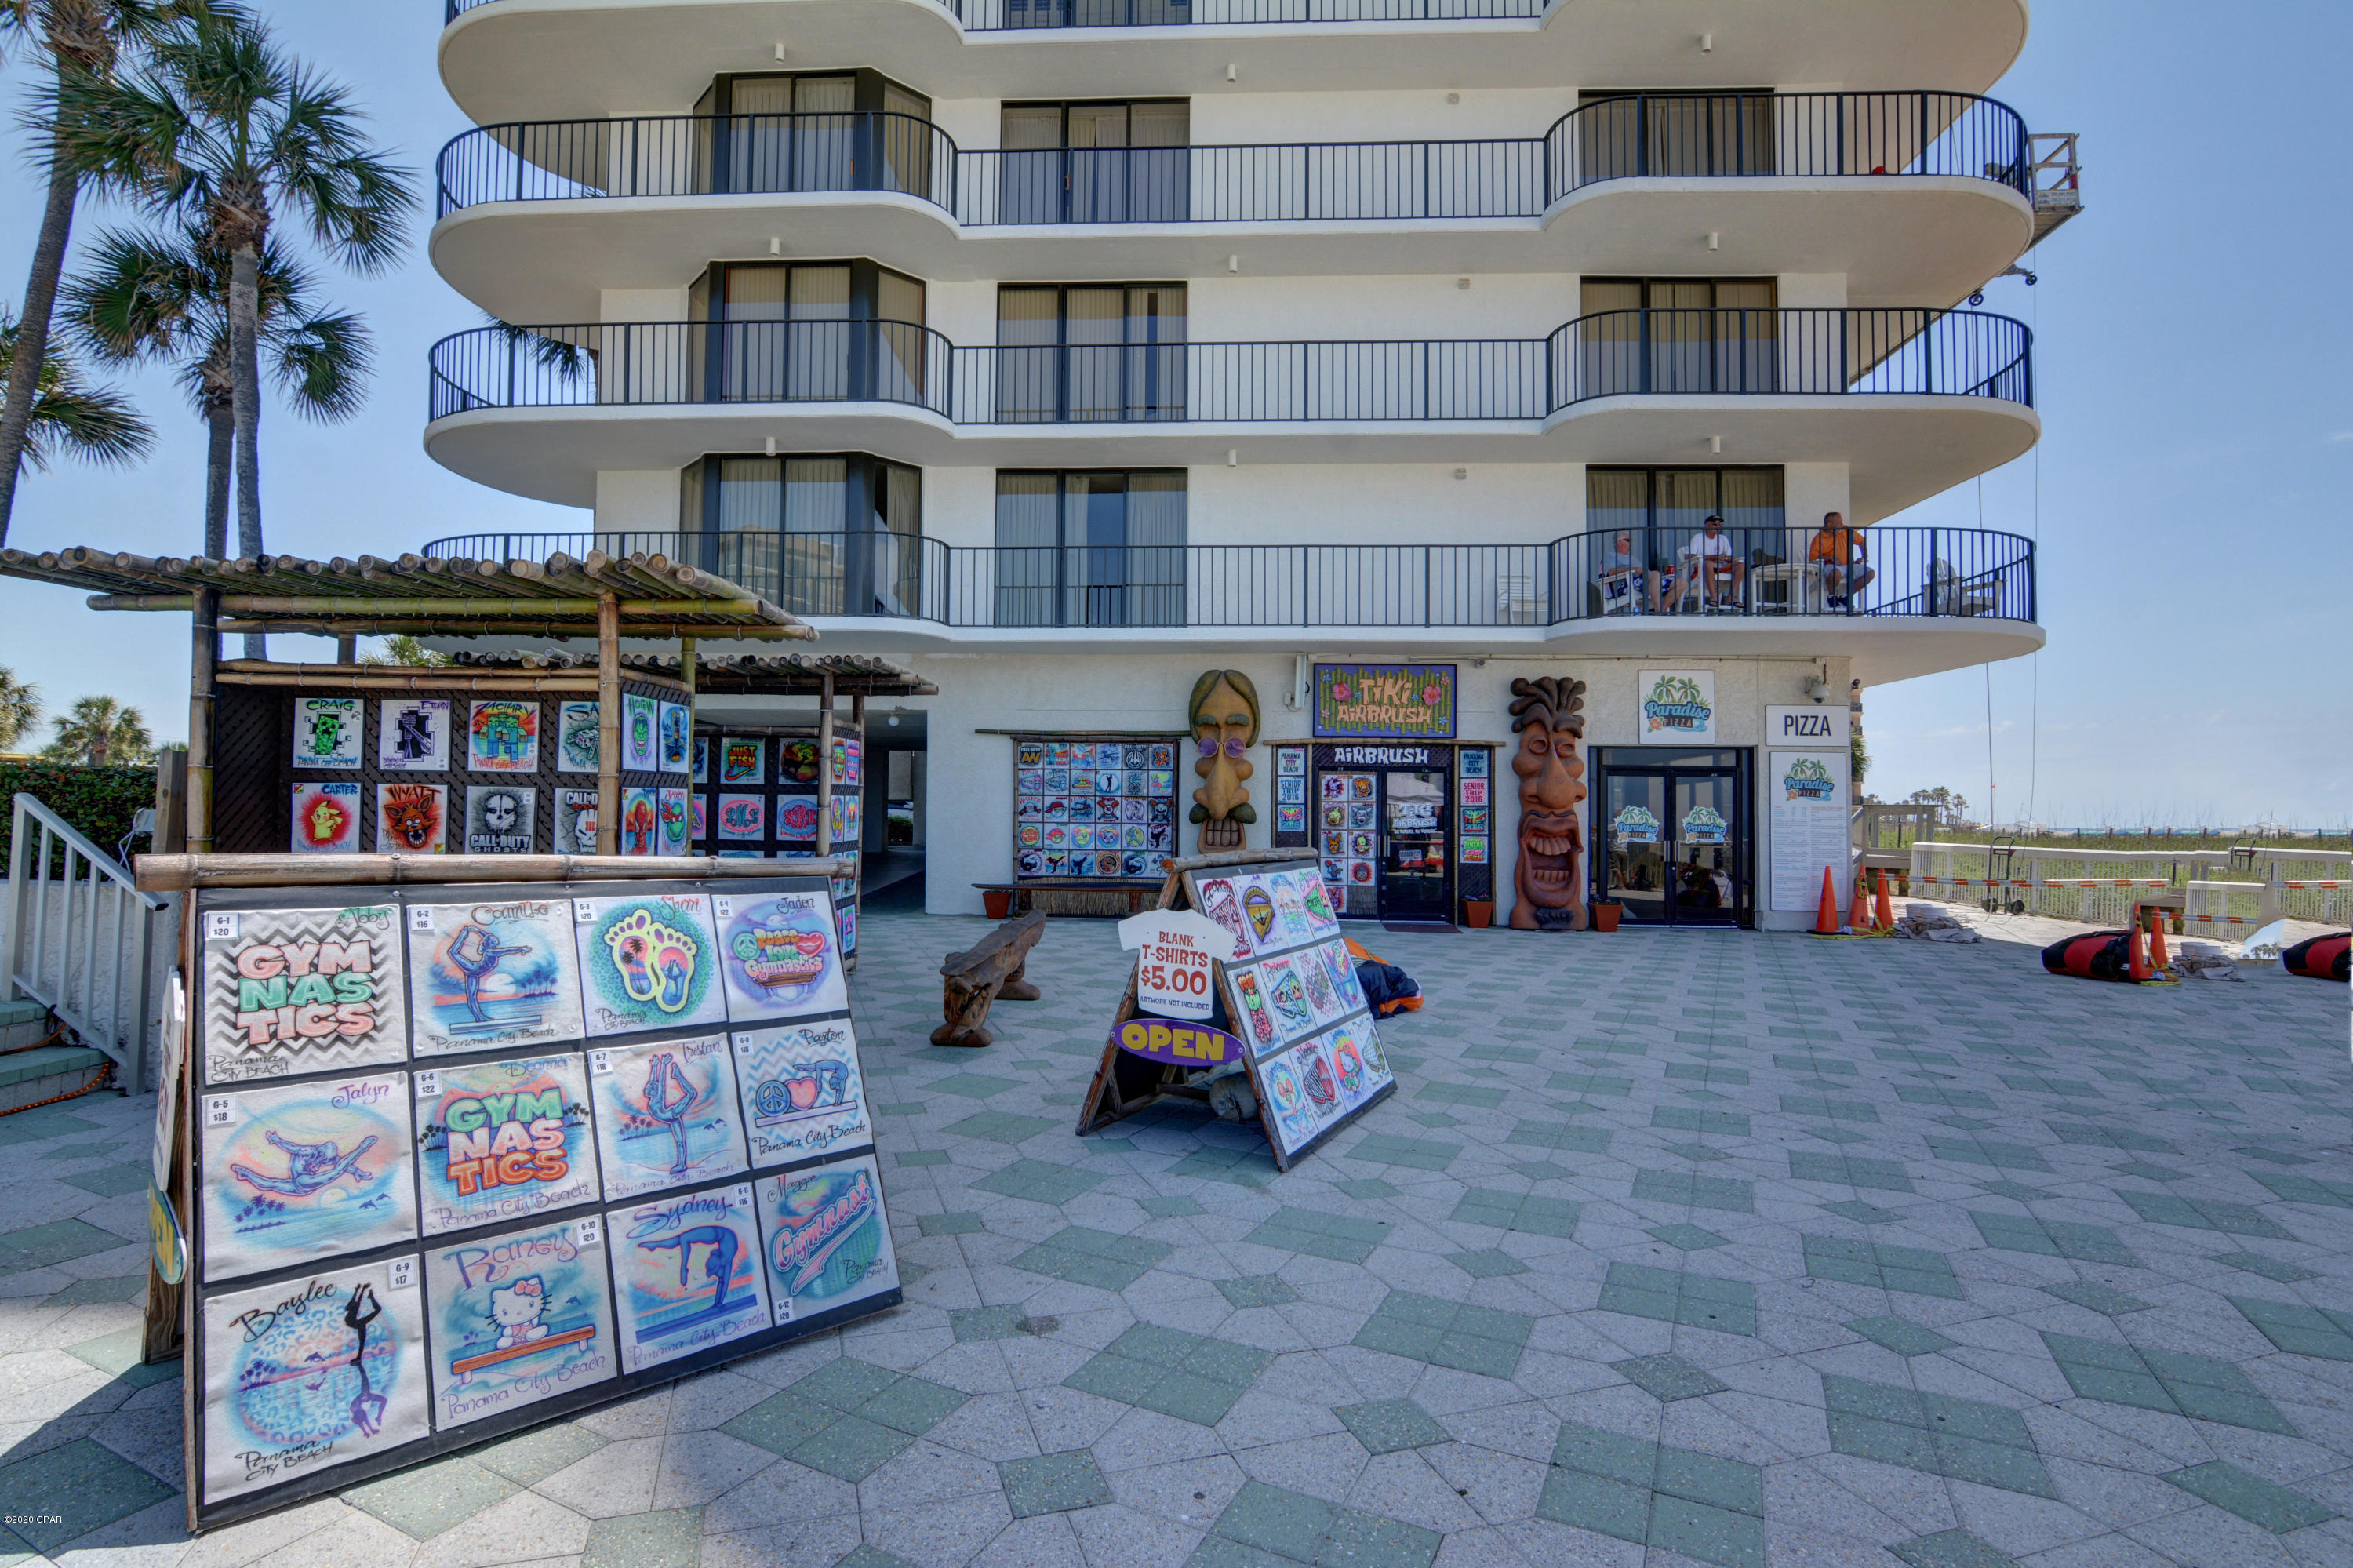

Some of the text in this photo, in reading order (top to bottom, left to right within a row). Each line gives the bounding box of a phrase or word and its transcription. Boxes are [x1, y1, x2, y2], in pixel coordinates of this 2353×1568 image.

[628, 695, 654, 718] HOGAN
[1644, 700, 1711, 721] Paradise
[1664, 718, 1692, 727] PIZZA
[1784, 715, 1831, 737] PIZZA
[729, 745, 757, 756] JUST
[321, 784, 358, 795] CARTER
[387, 784, 442, 802] WYATT
[1281, 780, 1301, 788] SENIOR
[1784, 777, 1835, 792] Paradise
[566, 792, 587, 804] CALL
[1617, 823, 1657, 834] Paradise
[1686, 824, 1726, 834] Paradise
[471, 835, 529, 848] CALL DUTY
[471, 902, 549, 926] Camille
[776, 896, 815, 915] Jaden
[216, 915, 230, 925] G-1
[336, 908, 391, 930] Abby
[416, 920, 427, 929] $16
[214, 928, 229, 937] $20
[753, 927, 800, 950] Peace
[1158, 931, 1195, 948] BLANK
[237, 940, 371, 980] GYM
[765, 944, 799, 962] Love
[1142, 944, 1209, 968] T-SHIRTS
[744, 954, 823, 980] Gymnastics
[1140, 965, 1207, 995] $5.00
[238, 973, 374, 1012] NAS
[1140, 995, 1167, 1006] ARTWORK
[1181, 1001, 1210, 1010] INCLUDED
[237, 1002, 375, 1046] TICS
[595, 1007, 647, 1024] Panama
[427, 1024, 558, 1051] Panama City Beach
[798, 1027, 846, 1048] Paxton
[1121, 1023, 1225, 1061] OPEN
[673, 1041, 723, 1063] Tristan
[207, 1054, 283, 1071] Panama
[245, 1062, 289, 1077] BEACH
[421, 1073, 434, 1082] G-6
[332, 1083, 389, 1109] Jalyn
[421, 1085, 435, 1093] $22
[213, 1101, 228, 1109] G-5
[445, 1086, 564, 1133] GYM
[213, 1112, 227, 1122] $18
[447, 1118, 566, 1165] NAS
[751, 1122, 867, 1156] Panama City Beach
[446, 1148, 569, 1196] TICS
[609, 1161, 736, 1197] Panama City Beach
[738, 1186, 749, 1195] G-11
[767, 1173, 820, 1204] Maggie
[433, 1180, 590, 1230] Panama City Beach
[739, 1198, 748, 1206] $16
[581, 1221, 595, 1231] G-10
[626, 1194, 733, 1239] Sydney
[773, 1169, 873, 1273] Gymnast
[583, 1232, 595, 1242] $20
[396, 1263, 409, 1272] G-9
[442, 1228, 578, 1292] Raney
[840, 1258, 882, 1278] Panama
[395, 1275, 408, 1285] $17
[229, 1280, 337, 1343] Baylee
[778, 1300, 790, 1310] G-12
[779, 1311, 790, 1321] $20
[628, 1311, 766, 1367] Panama City Beach
[441, 1348, 606, 1420] Panama City Beach
[234, 1439, 322, 1471] Panama
[284, 1441, 333, 1468] BEACH
